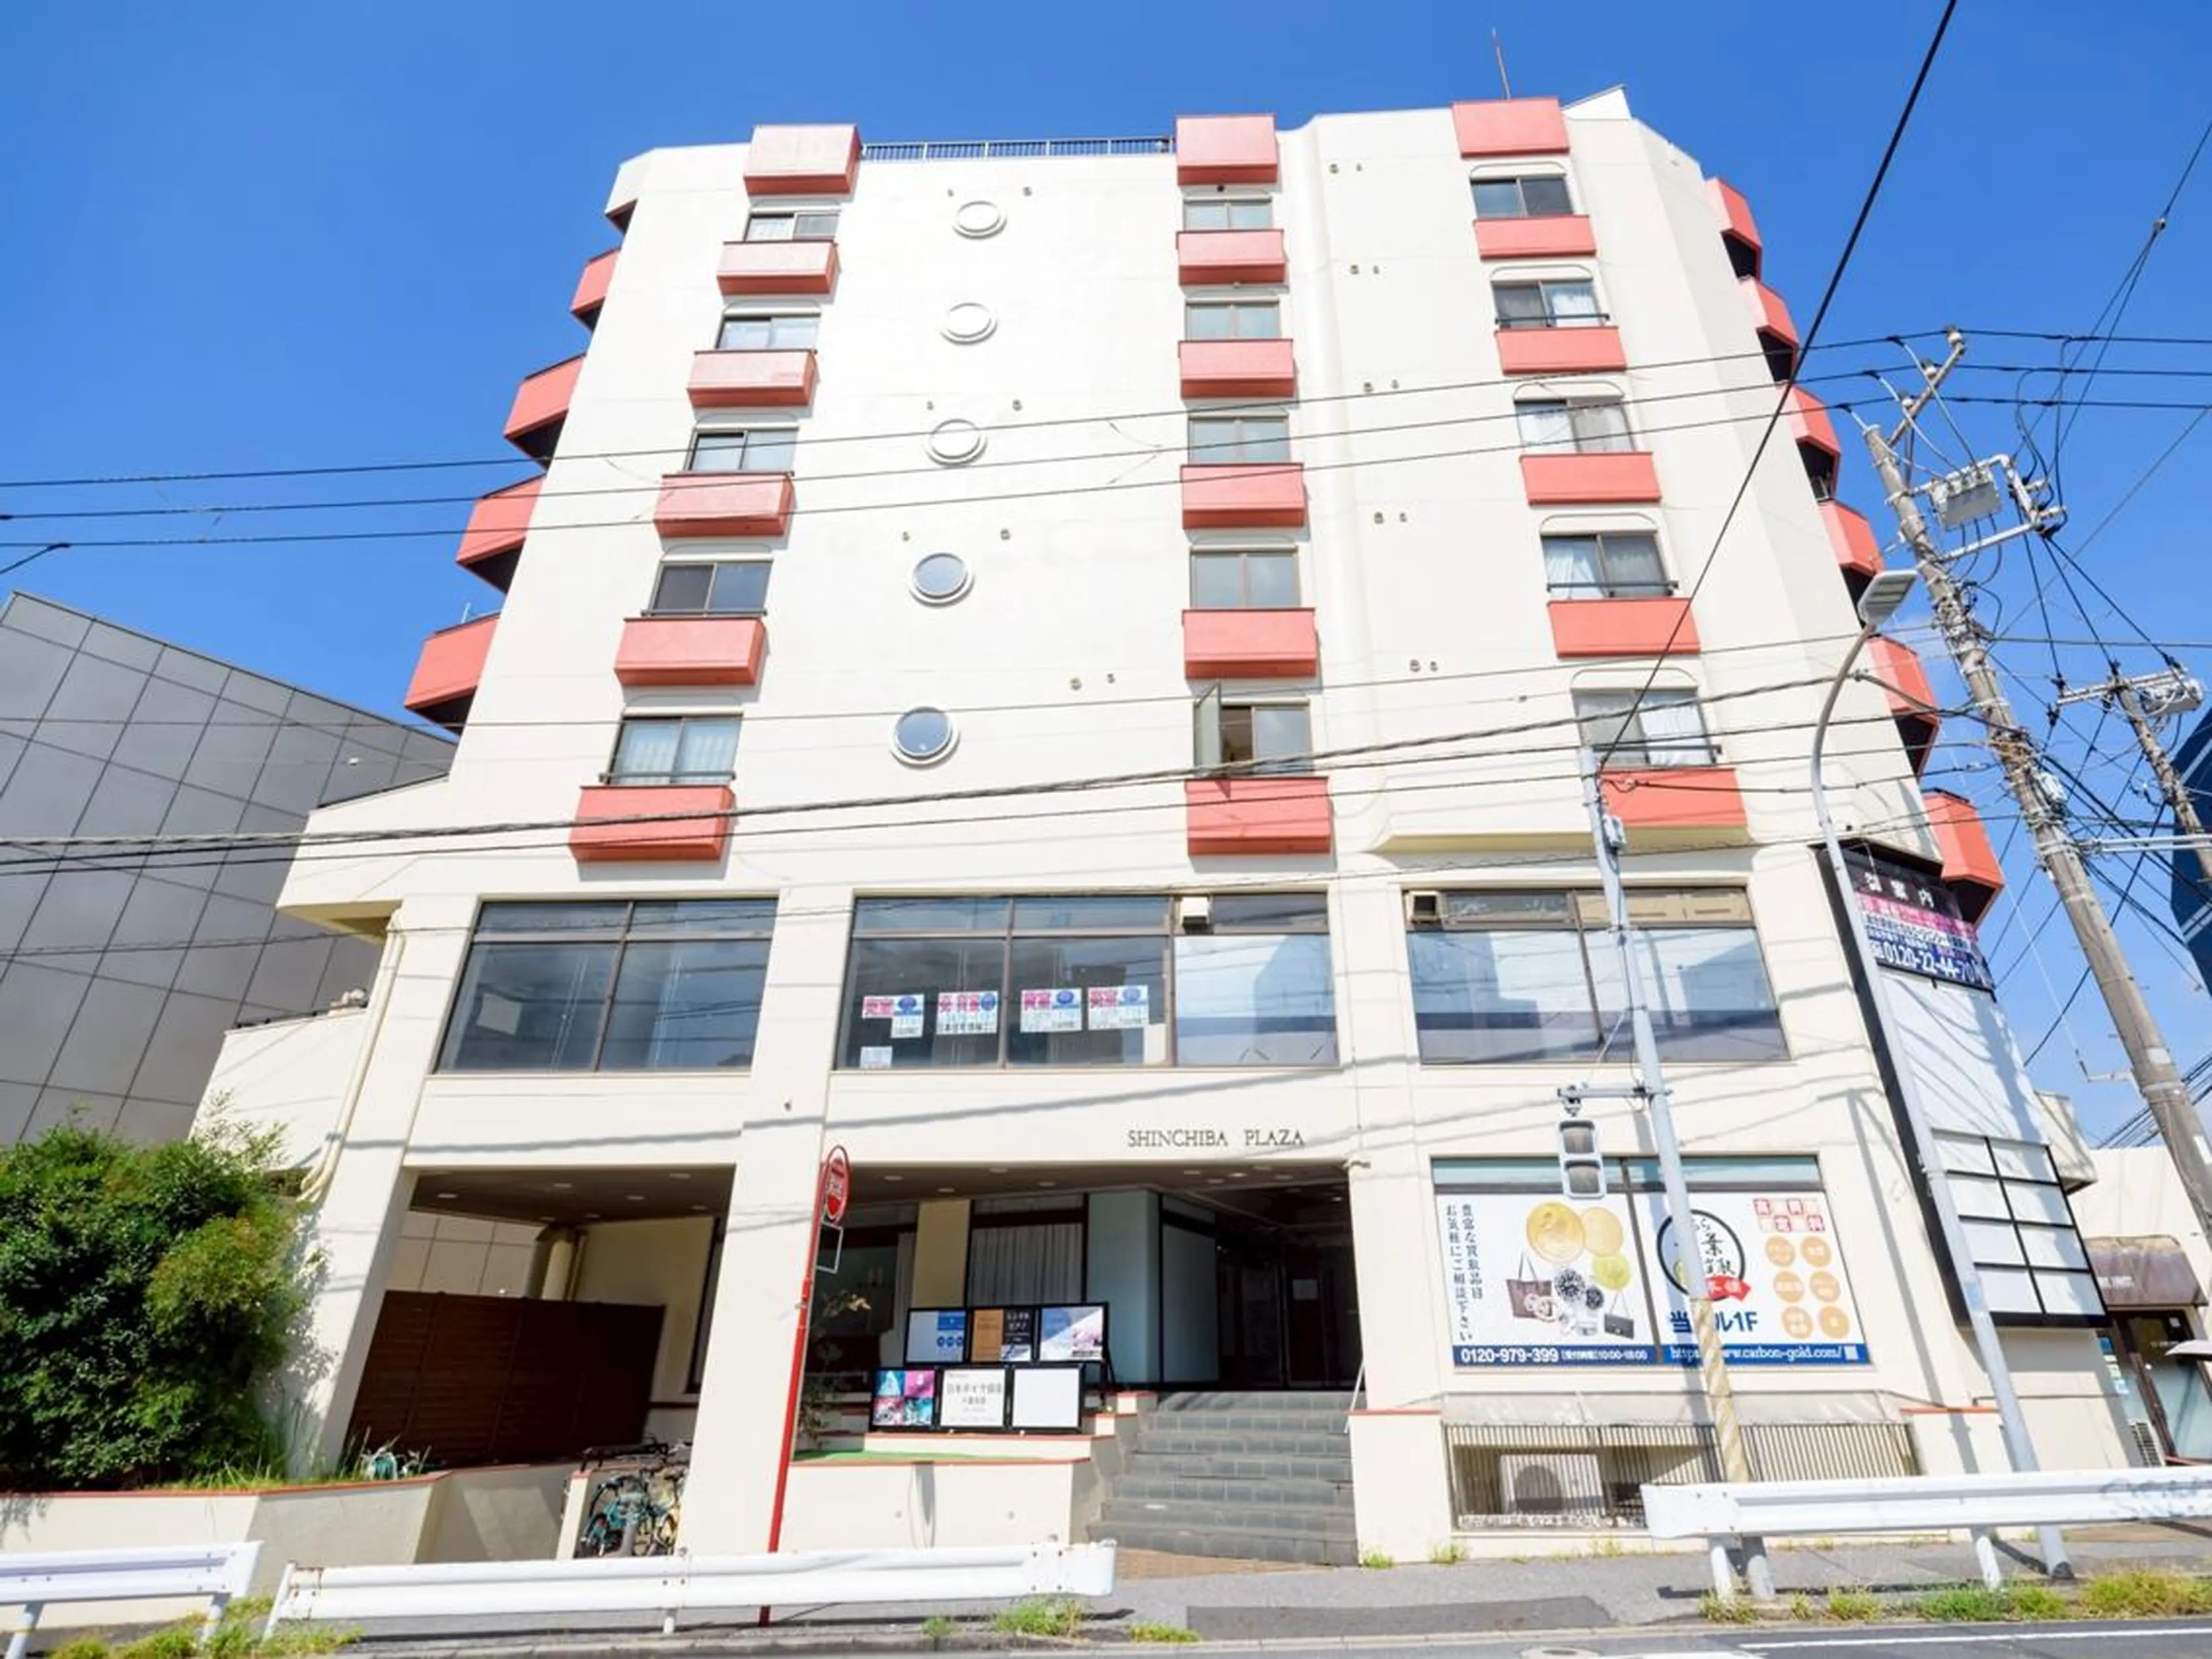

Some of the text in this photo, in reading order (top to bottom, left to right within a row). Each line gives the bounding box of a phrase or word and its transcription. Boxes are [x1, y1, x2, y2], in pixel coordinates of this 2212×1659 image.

[1127, 1128, 1306, 1147] SHINCHIBA PLAZA
[1669, 1310, 1758, 1334] 当ル1F
[1461, 1347, 1559, 1363] 0120-979-399
